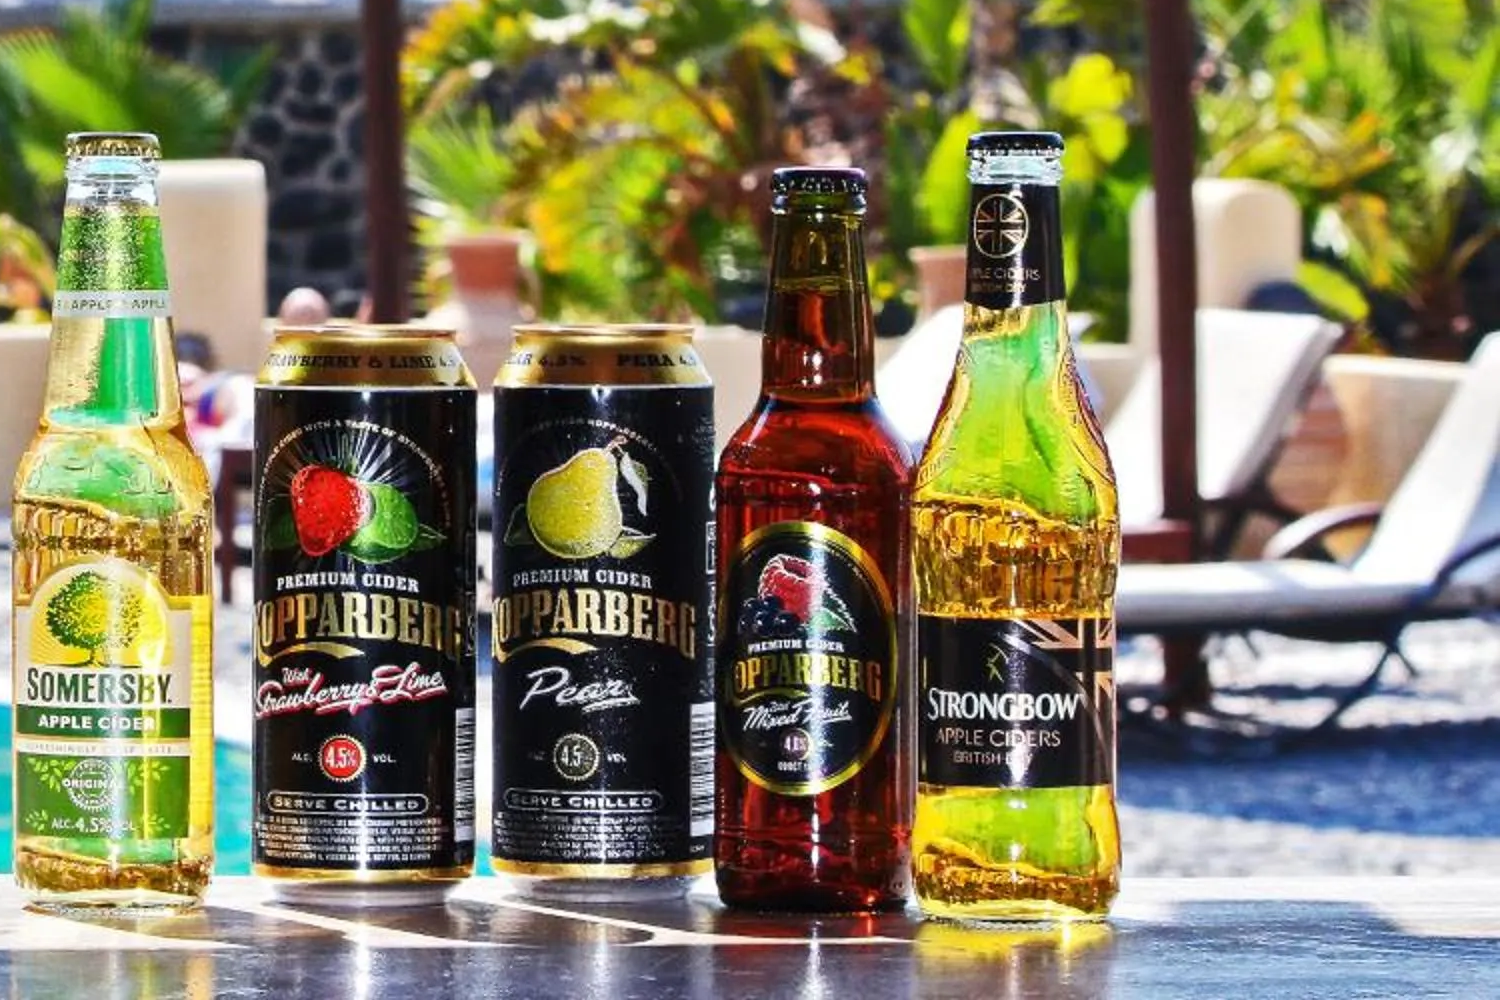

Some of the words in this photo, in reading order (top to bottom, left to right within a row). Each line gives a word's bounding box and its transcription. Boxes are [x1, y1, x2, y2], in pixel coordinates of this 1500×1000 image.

[390, 356, 437, 369] LIME
[276, 571, 356, 591] PREMIUM
[361, 574, 420, 593] CIDER
[513, 570, 589, 588] PREMIUM
[595, 569, 653, 589] CIDER
[729, 653, 882, 702] OPPARBERG
[928, 687, 1079, 721] STRONGBOW
[37, 714, 93, 730] APPLE
[97, 715, 156, 732] CIDER
[936, 727, 984, 746] APPLE
[988, 729, 1062, 748] CIDERS
[325, 746, 358, 769] 4.5%
[953, 751, 1002, 766] BRITISH
[1005, 751, 1034, 766] DY
[61, 778, 125, 790] ORIGINA
[274, 796, 327, 809] SERVE
[333, 799, 420, 812] CHILLED
[568, 796, 654, 809] CHILLED
